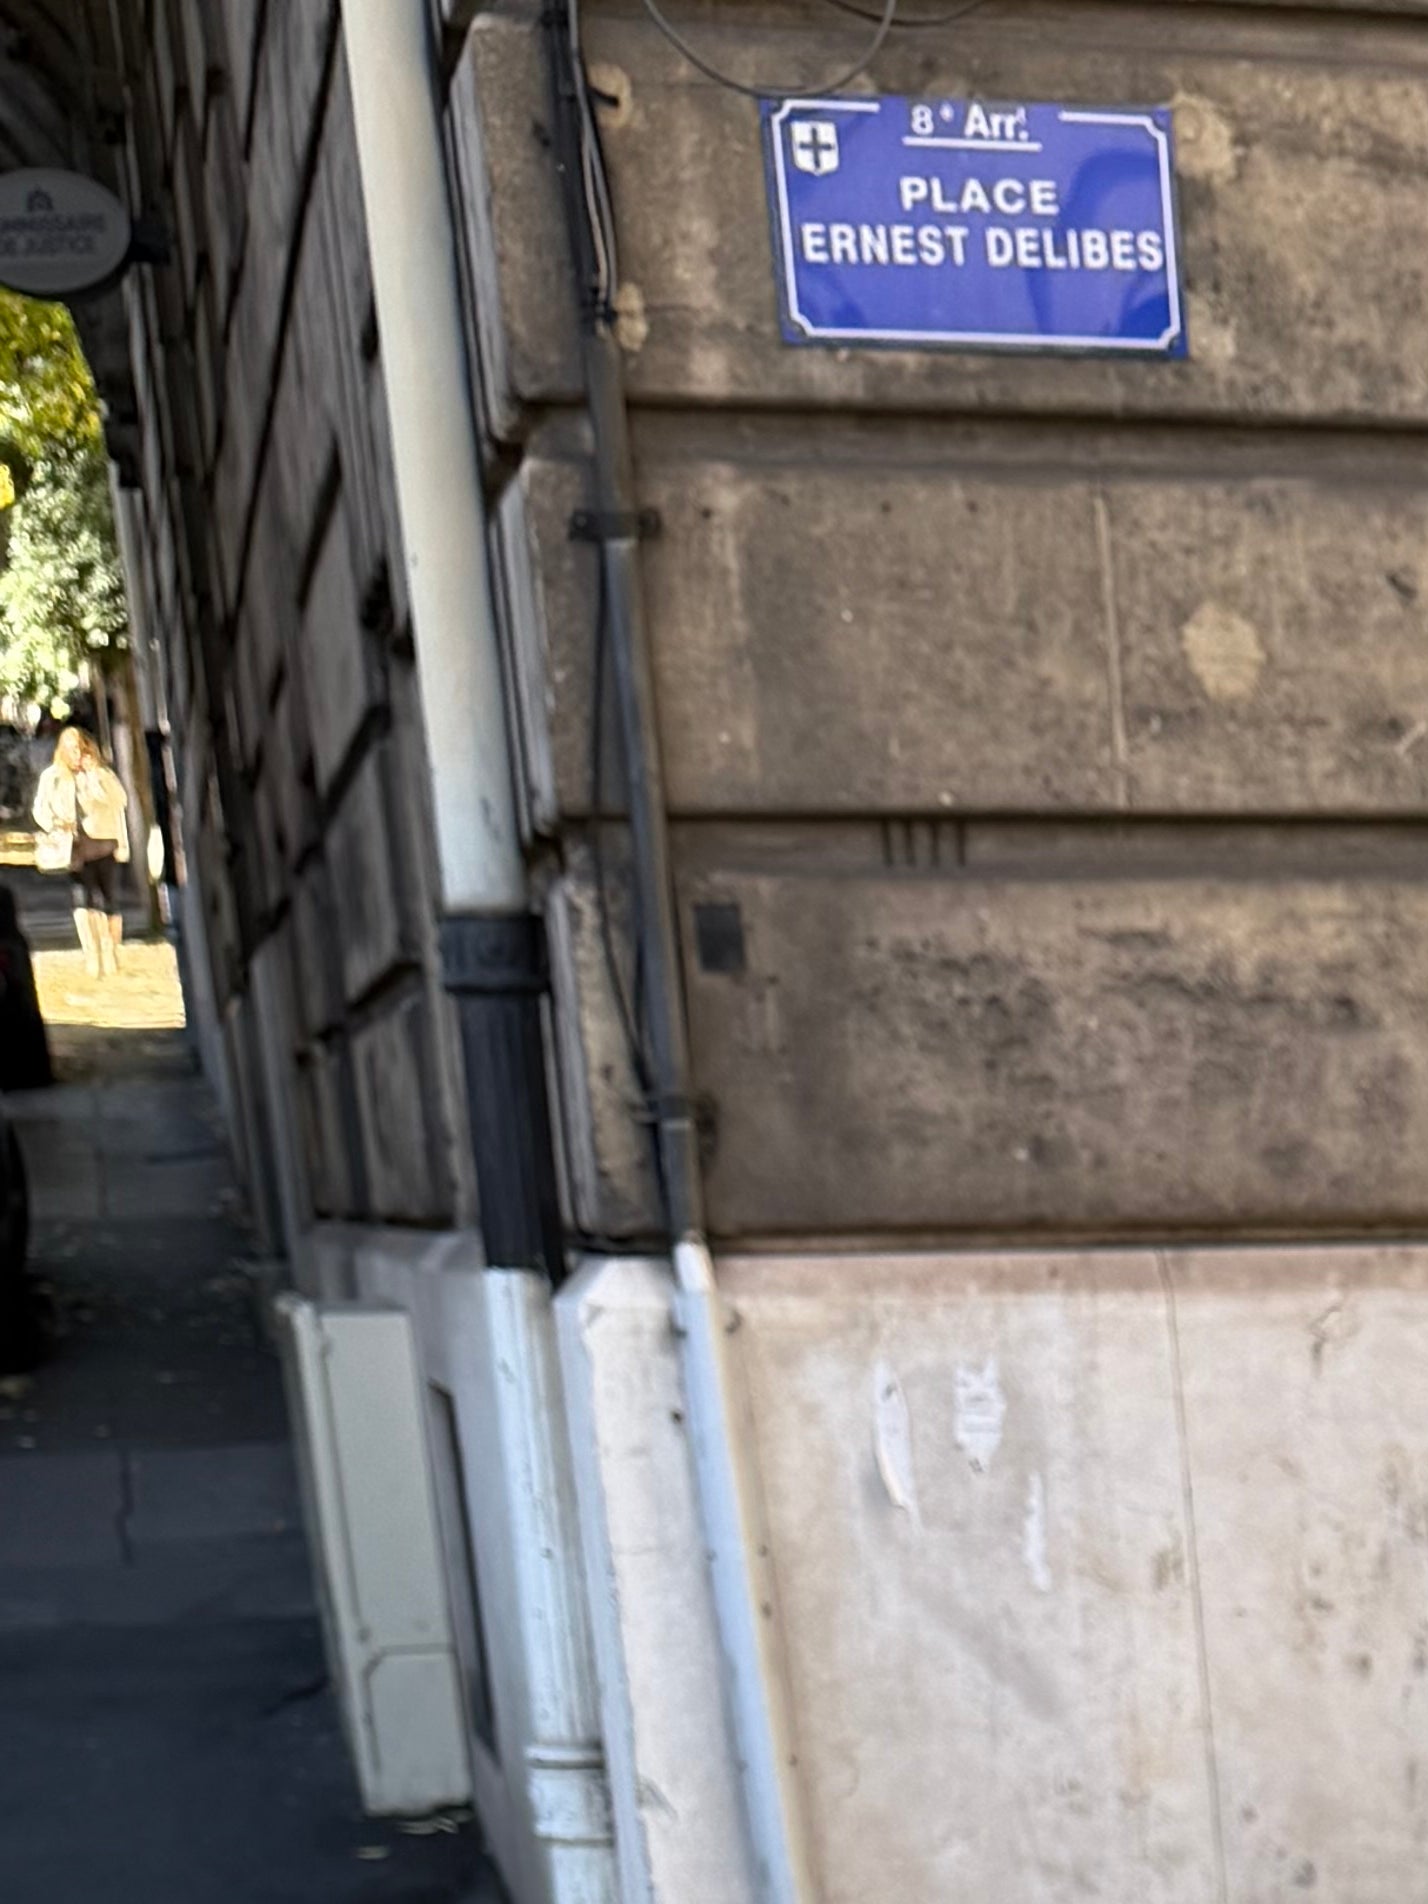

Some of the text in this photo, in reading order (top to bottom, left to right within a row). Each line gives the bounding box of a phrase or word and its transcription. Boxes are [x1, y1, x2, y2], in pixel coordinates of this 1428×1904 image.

[899, 176, 1060, 215] PLACE
[801, 223, 1164, 271] ERNEST DELIBES
